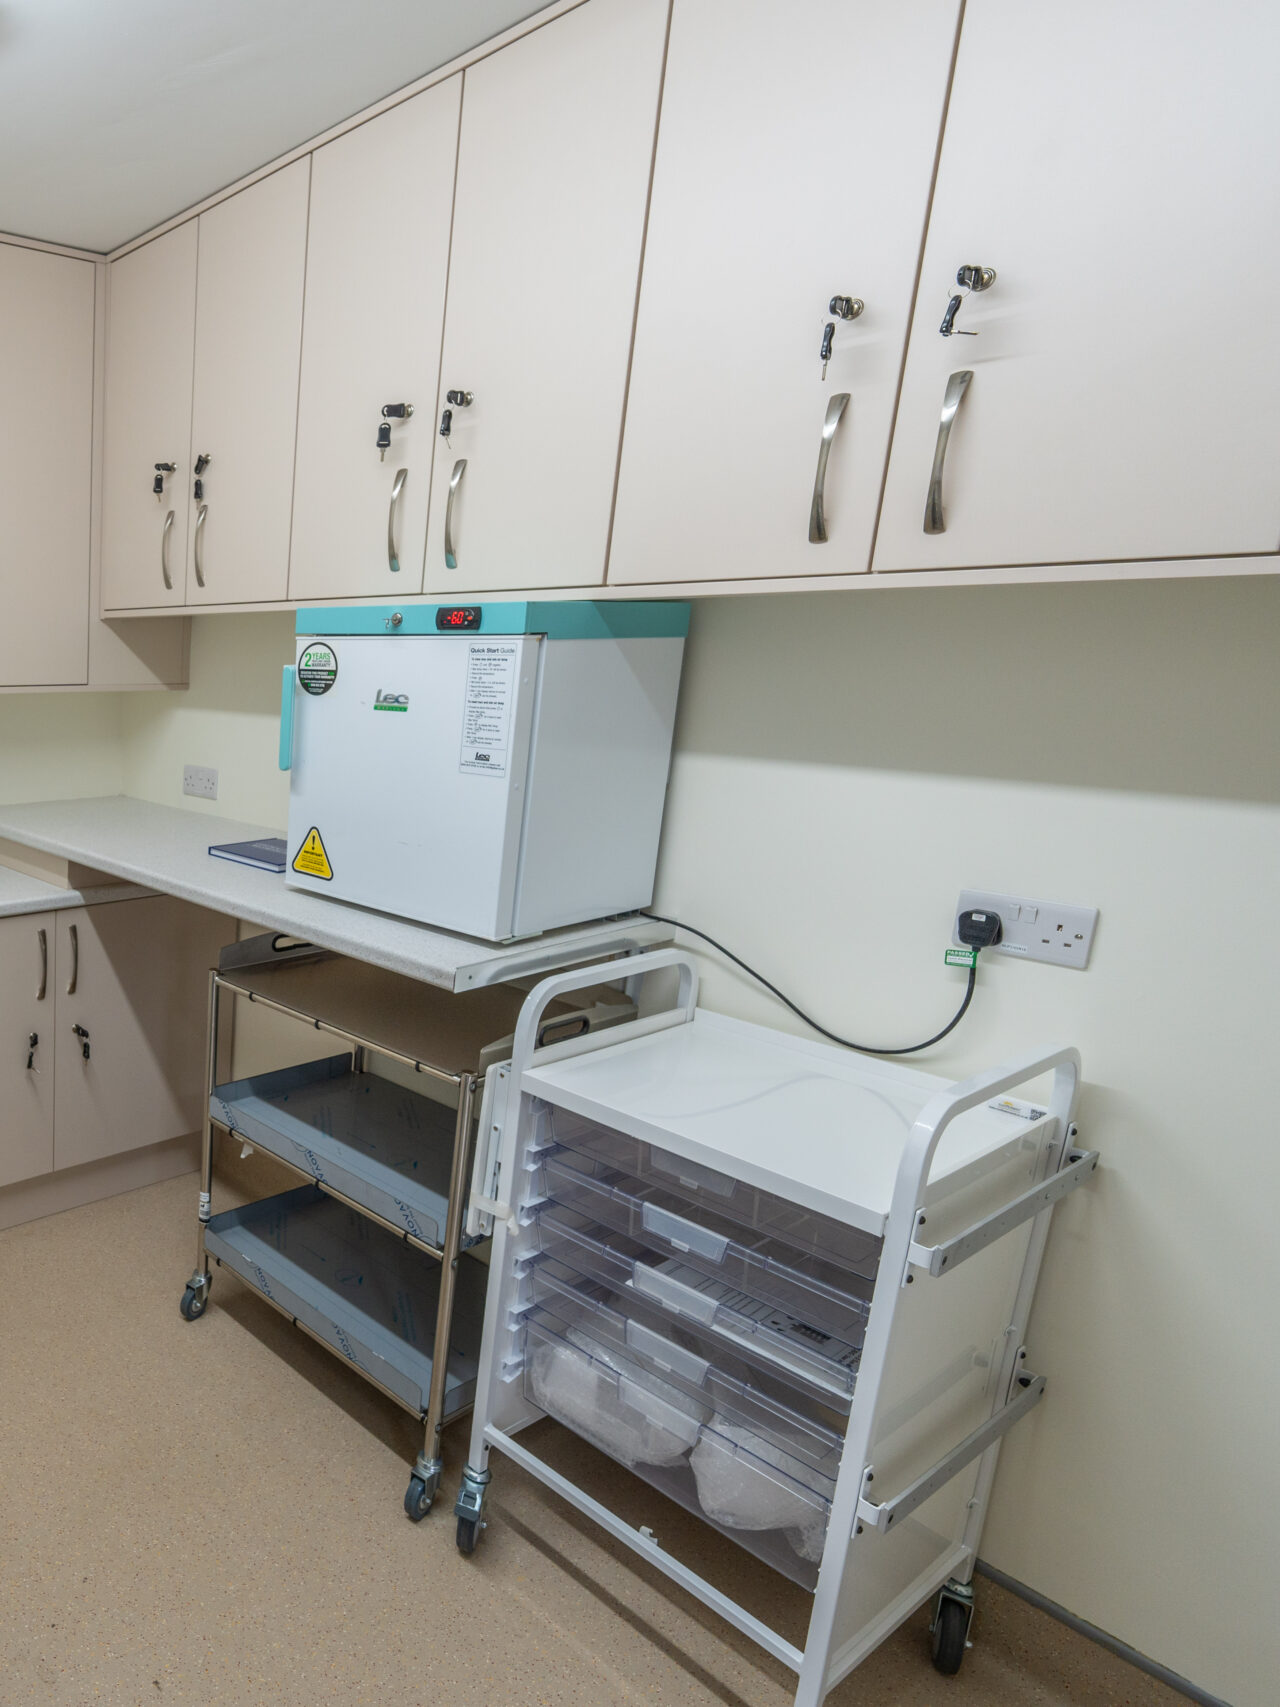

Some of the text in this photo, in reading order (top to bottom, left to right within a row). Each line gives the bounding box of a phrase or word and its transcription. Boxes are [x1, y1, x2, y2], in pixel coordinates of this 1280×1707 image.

[304, 652, 331, 667] 2 YEARS
[375, 688, 410, 704] Lec
